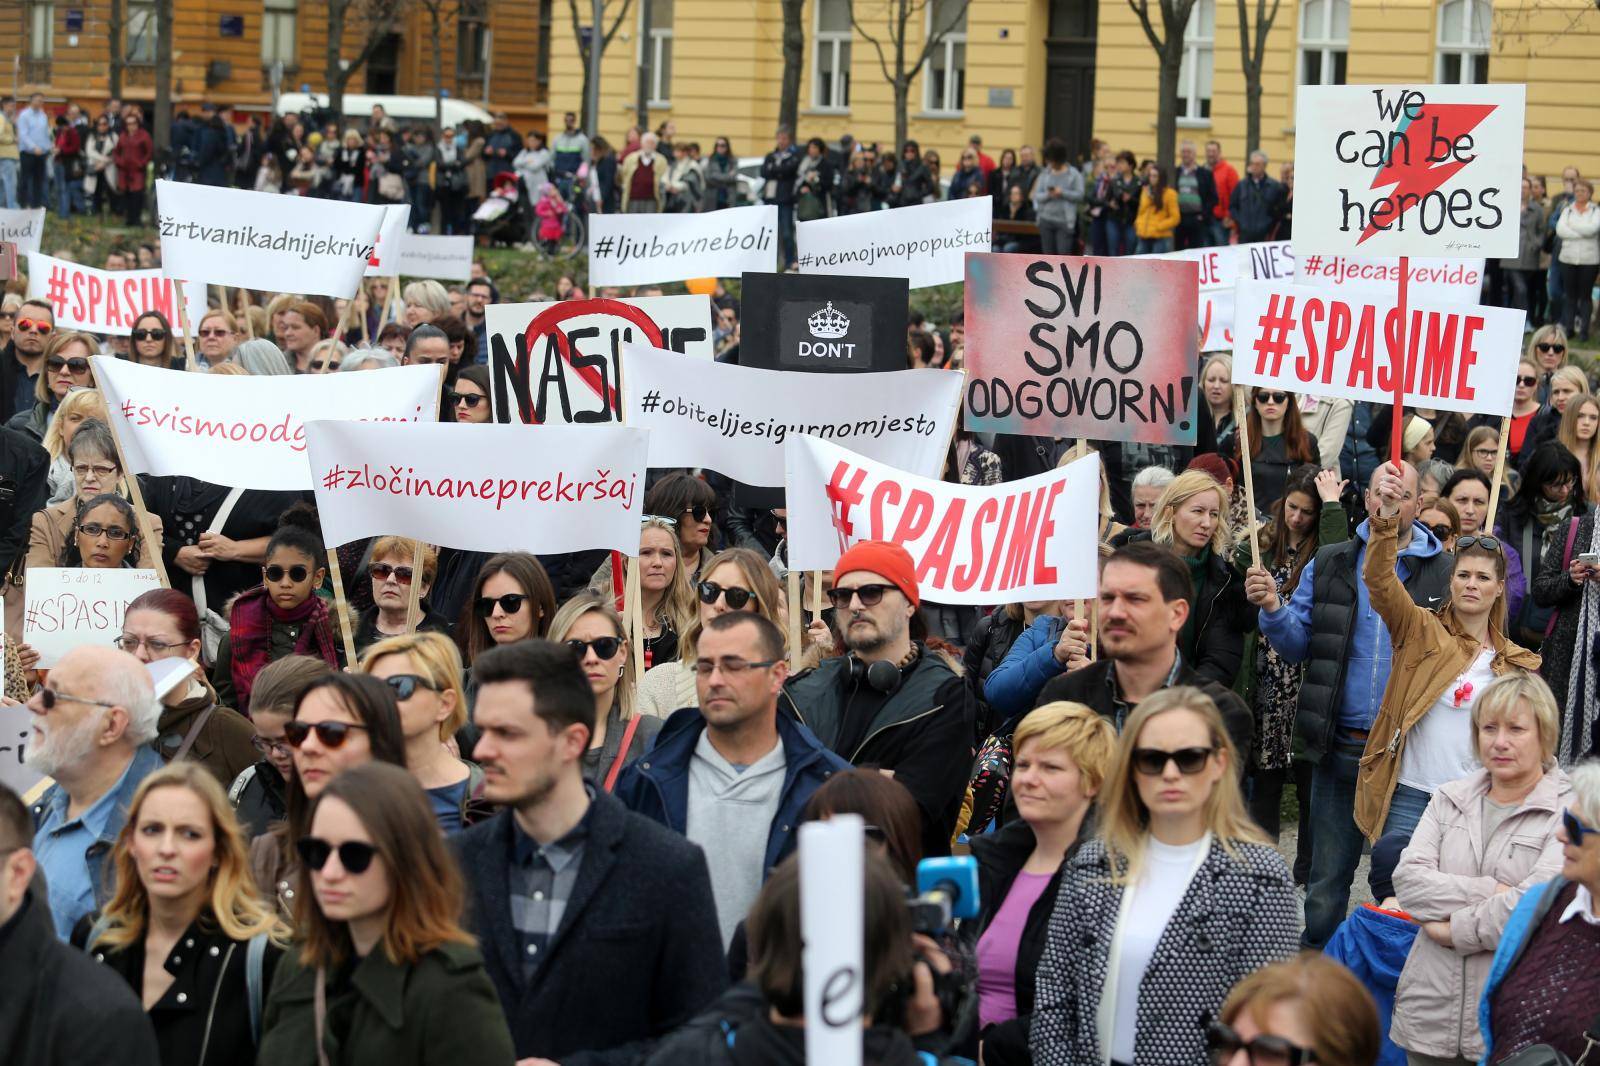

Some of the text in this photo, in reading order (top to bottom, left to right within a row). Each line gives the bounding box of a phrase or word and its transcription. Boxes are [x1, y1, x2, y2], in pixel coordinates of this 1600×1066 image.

[1372, 89, 1426, 123] we
[1336, 116, 1477, 168] can be
[1338, 187, 1503, 236] heroes
[593, 226, 773, 265] #ljubavneboli
[1024, 261, 1101, 319] SVI
[798, 341, 856, 359] DON'T
[1024, 320, 1144, 376] SMO
[1253, 293, 1485, 401] #SPASIME
[490, 326, 707, 424] NASI
[967, 376, 1194, 431] ODGOVORN!
[323, 463, 637, 511] #zločinaneprekršaj
[825, 460, 1067, 593] #SPASIME
